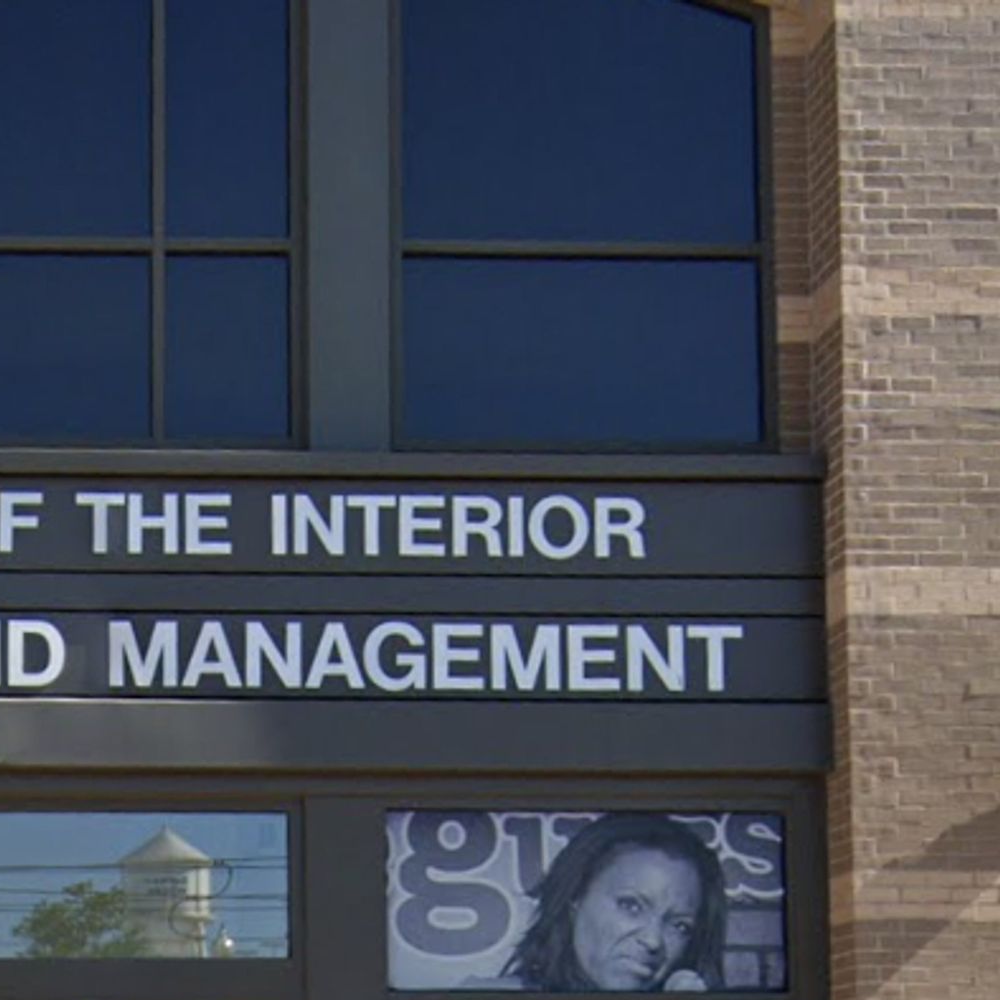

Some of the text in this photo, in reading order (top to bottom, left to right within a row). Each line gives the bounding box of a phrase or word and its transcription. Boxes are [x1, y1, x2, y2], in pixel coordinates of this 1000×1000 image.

[75, 491, 234, 557] THE
[270, 493, 647, 561] INTERIOR
[108, 620, 744, 692] MANAGEMENT
